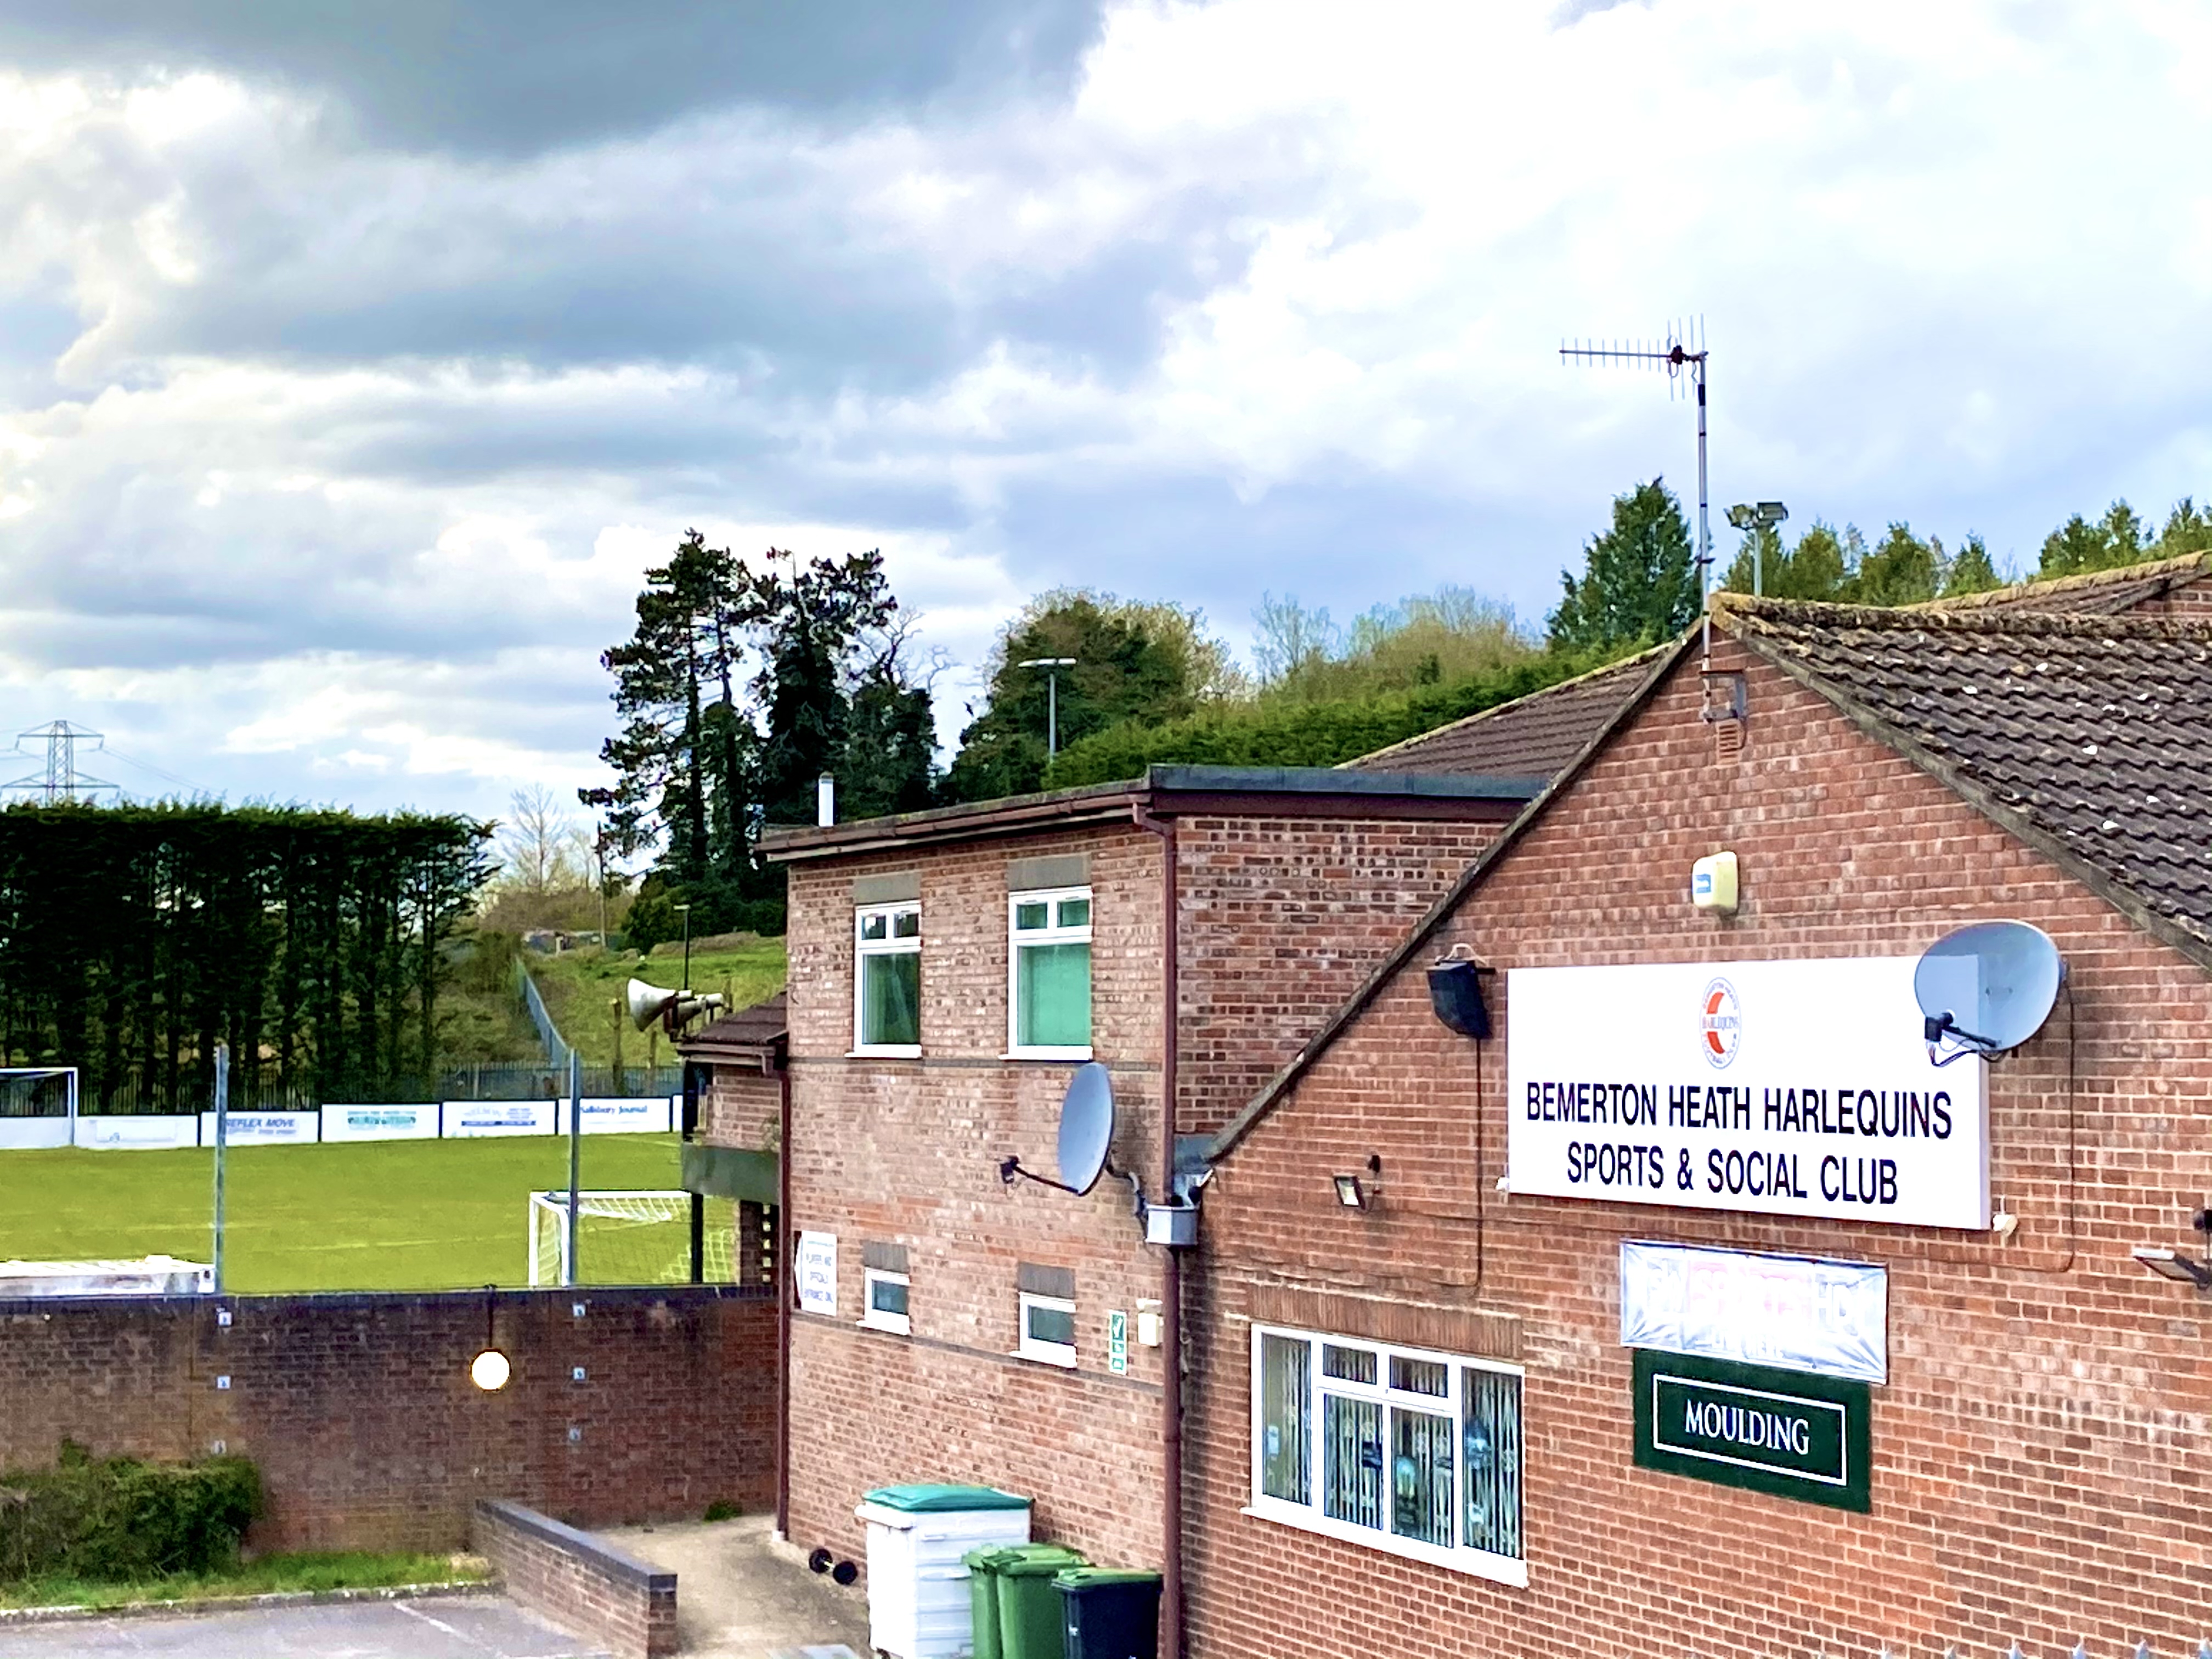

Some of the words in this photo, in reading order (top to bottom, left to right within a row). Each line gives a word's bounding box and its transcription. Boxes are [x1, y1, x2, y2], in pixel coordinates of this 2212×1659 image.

[266, 1118, 295, 1127] MOVE
[618, 1105, 647, 1114] Journal
[1528, 1082, 1656, 1125] BEMERTON
[1669, 1085, 1750, 1130] HEATH
[1765, 1088, 1951, 1139] HARLEQUINS
[1568, 1142, 1663, 1188] SPORTS
[1678, 1148, 1694, 1190] &
[1708, 1149, 1807, 1198] SOCIAL
[1821, 1155, 1898, 1204] CLUB
[1686, 1400, 1809, 1454] MOULDING
